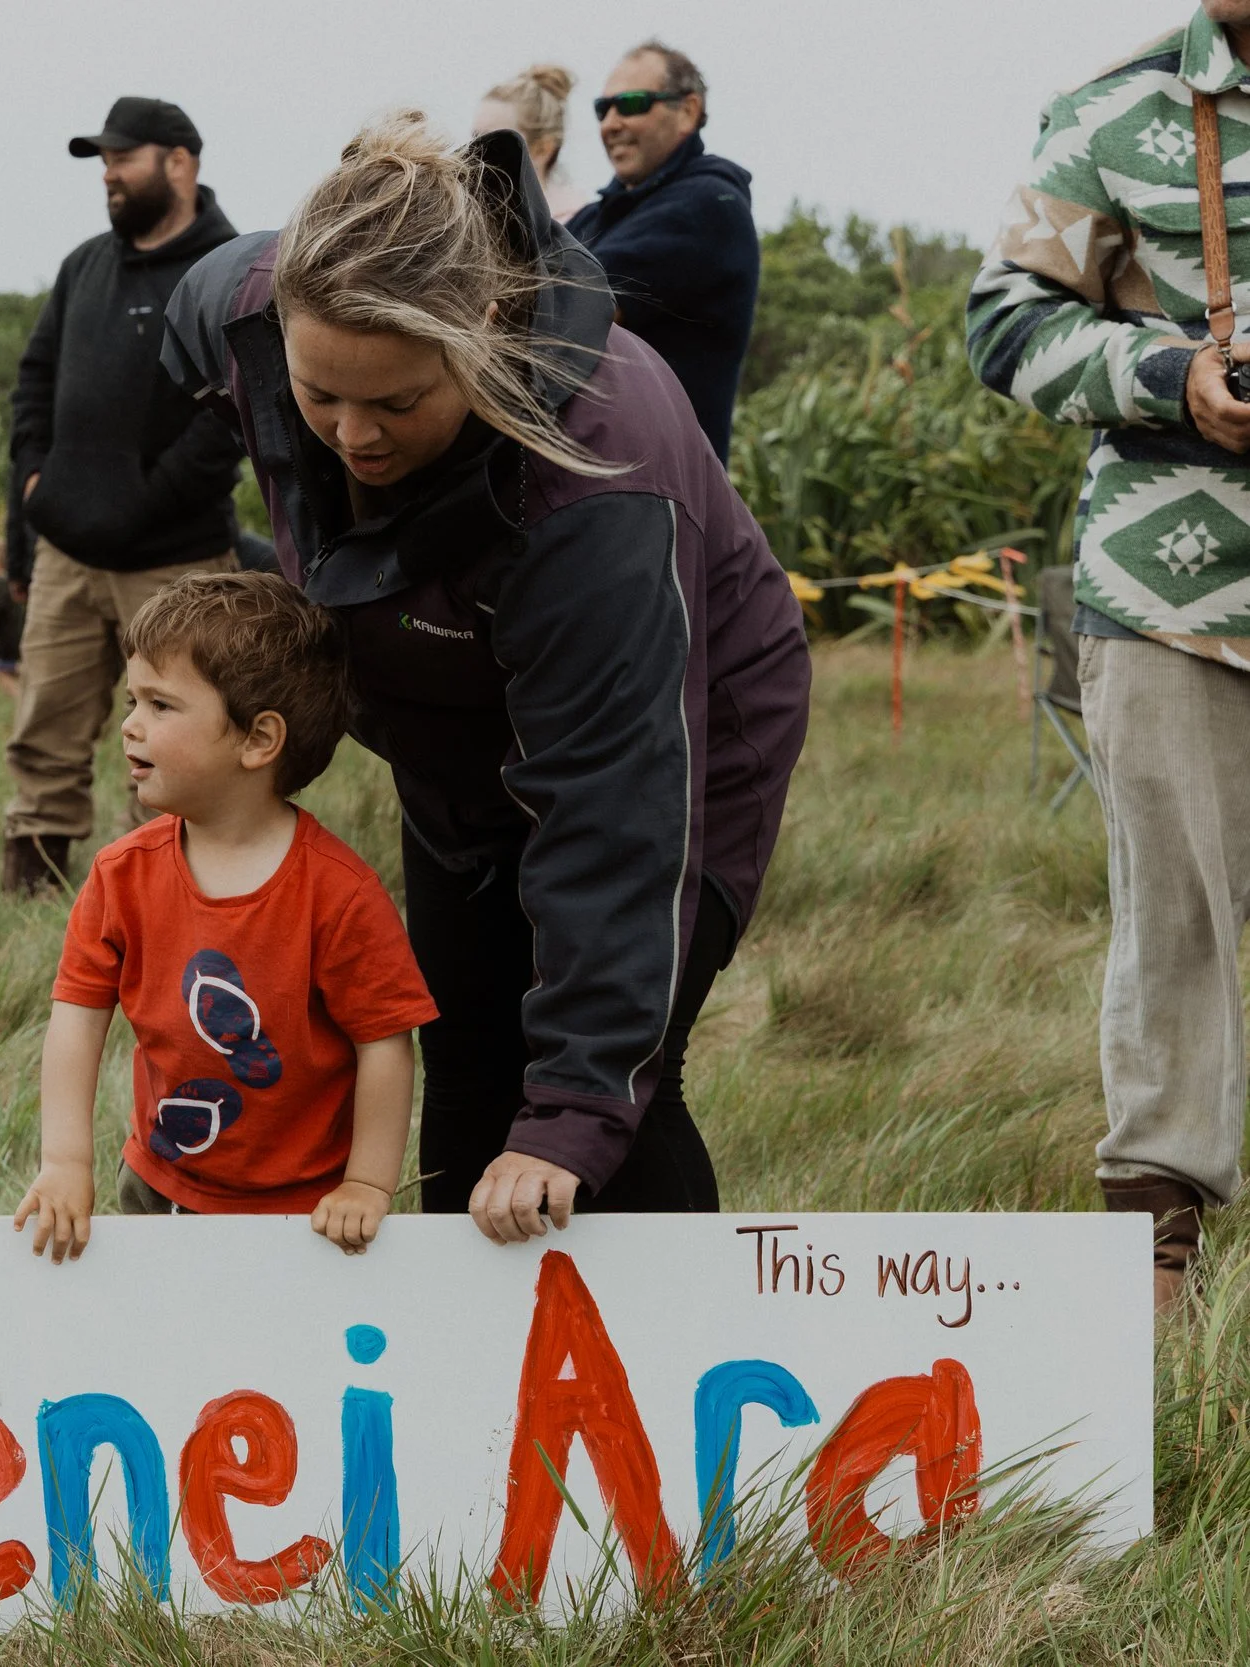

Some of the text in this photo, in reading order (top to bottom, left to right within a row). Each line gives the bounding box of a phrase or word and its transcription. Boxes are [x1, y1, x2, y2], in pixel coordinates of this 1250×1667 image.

[413, 618, 474, 639] KAIWAKA
[736, 1224, 1021, 1328] This way...
[488, 1249, 982, 1613] Ara
